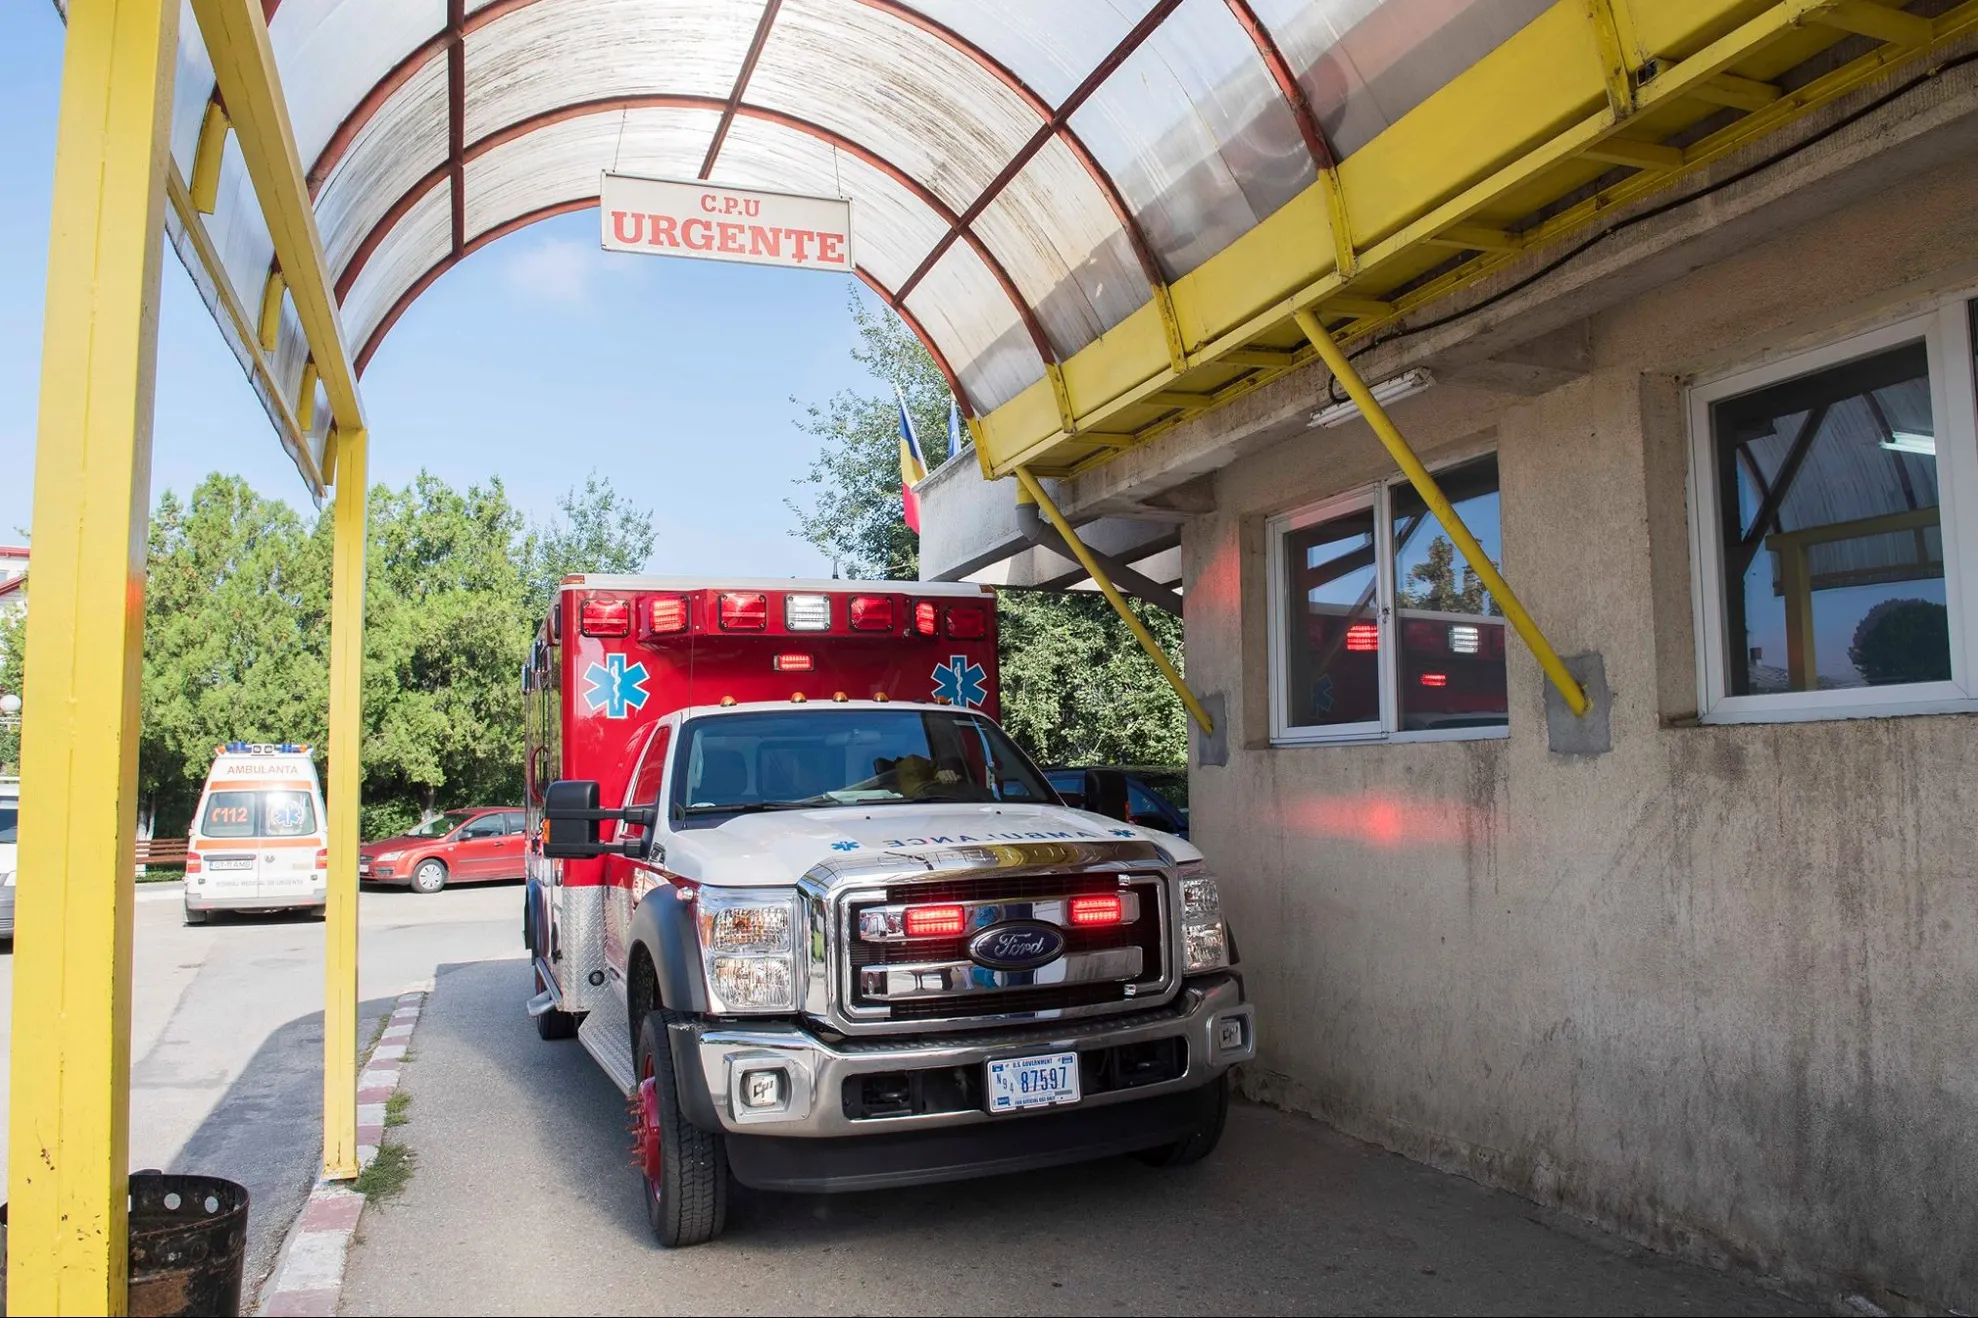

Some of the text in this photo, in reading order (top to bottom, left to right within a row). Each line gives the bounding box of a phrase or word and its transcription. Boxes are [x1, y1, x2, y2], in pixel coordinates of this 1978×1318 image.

[701, 194, 760, 216] C.P.U
[227, 765, 298, 775] AMBULANTA
[221, 807, 248, 823] 112
[994, 932, 1044, 957] Ford
[1022, 1058, 1052, 1067] GOVERNMENT
[1021, 1066, 1066, 1093] 87597
